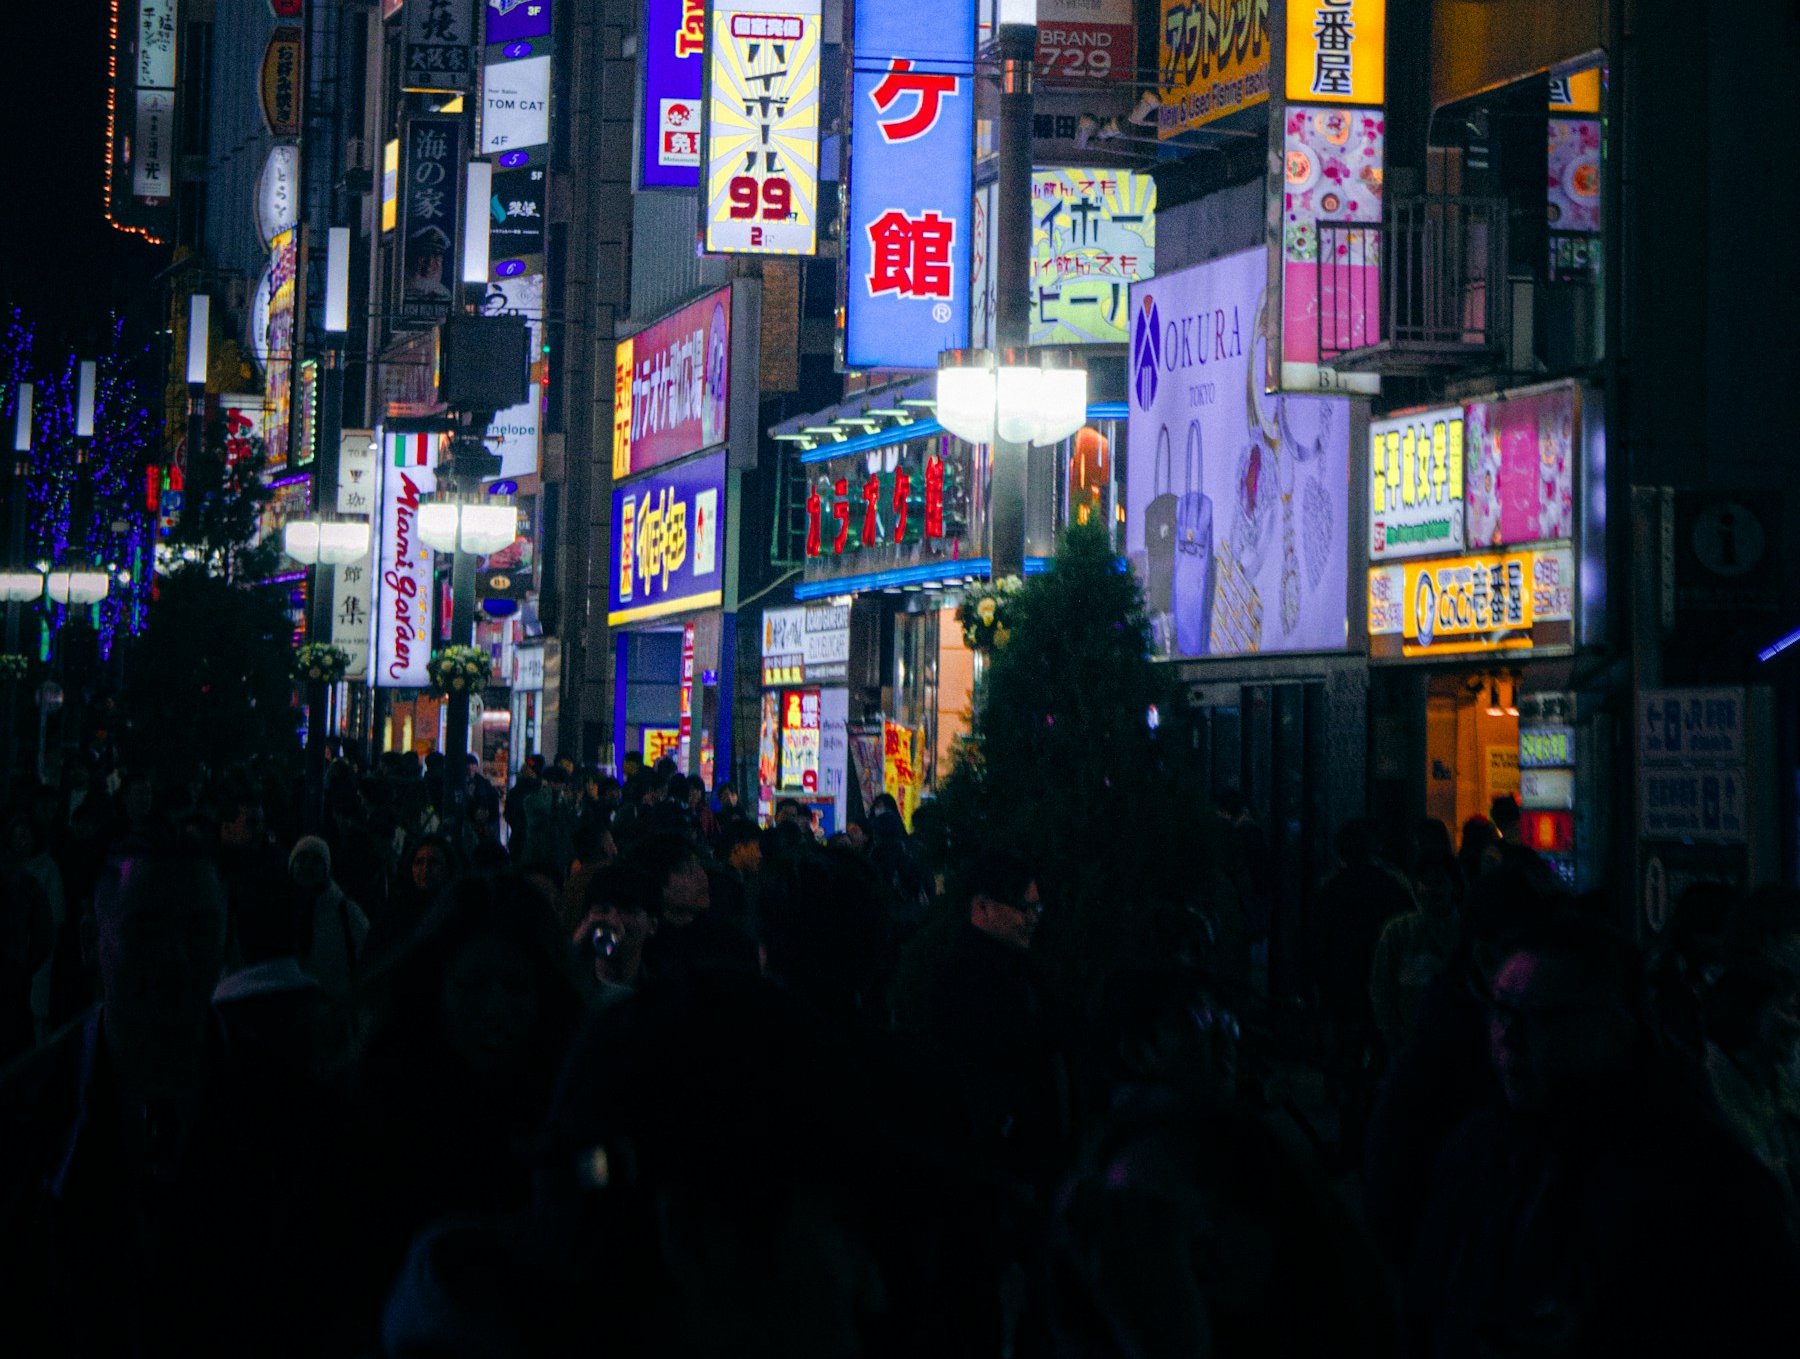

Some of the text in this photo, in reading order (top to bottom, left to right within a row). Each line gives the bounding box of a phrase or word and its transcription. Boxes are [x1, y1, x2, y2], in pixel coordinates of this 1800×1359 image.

[527, 6, 542, 17] 3F
[1040, 29, 1113, 47] BRAND
[1039, 47, 1112, 79] 729
[488, 98, 545, 112] TOM CAT
[490, 135, 509, 147] 4F
[509, 152, 520, 166] 5
[414, 129, 448, 221] 海の家
[1164, 305, 1242, 372] OKURA
[631, 328, 704, 443] カラオケ歌広場
[1189, 382, 1216, 408] TOKYO
[805, 455, 944, 558] カラオケ館
